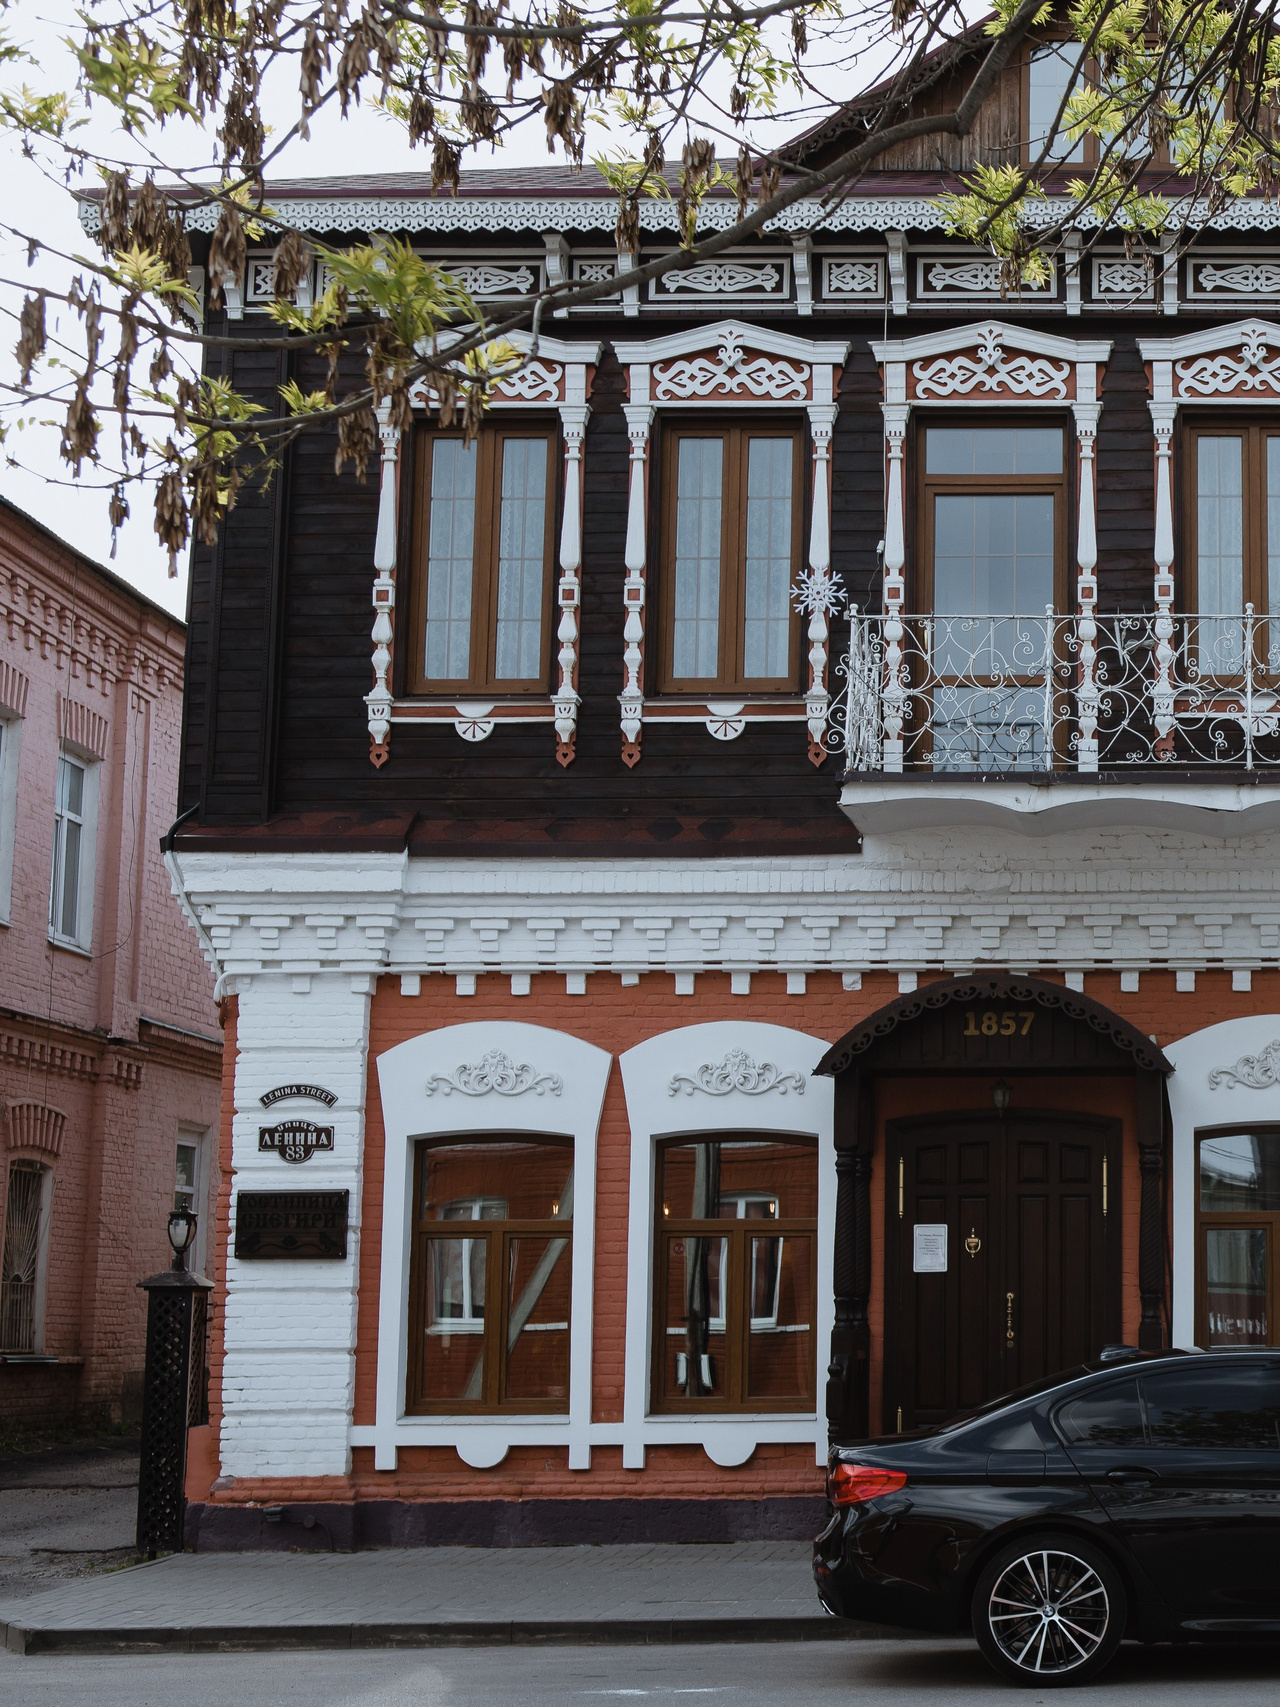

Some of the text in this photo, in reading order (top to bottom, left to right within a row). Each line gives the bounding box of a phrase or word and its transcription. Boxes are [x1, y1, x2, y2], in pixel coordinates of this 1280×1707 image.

[963, 1011, 1035, 1036] 1857
[263, 1086, 333, 1103] LENINA STREET
[277, 1121, 315, 1131] улица
[262, 1132, 329, 1145] ЛЕНИНА
[285, 1145, 305, 1160] 83
